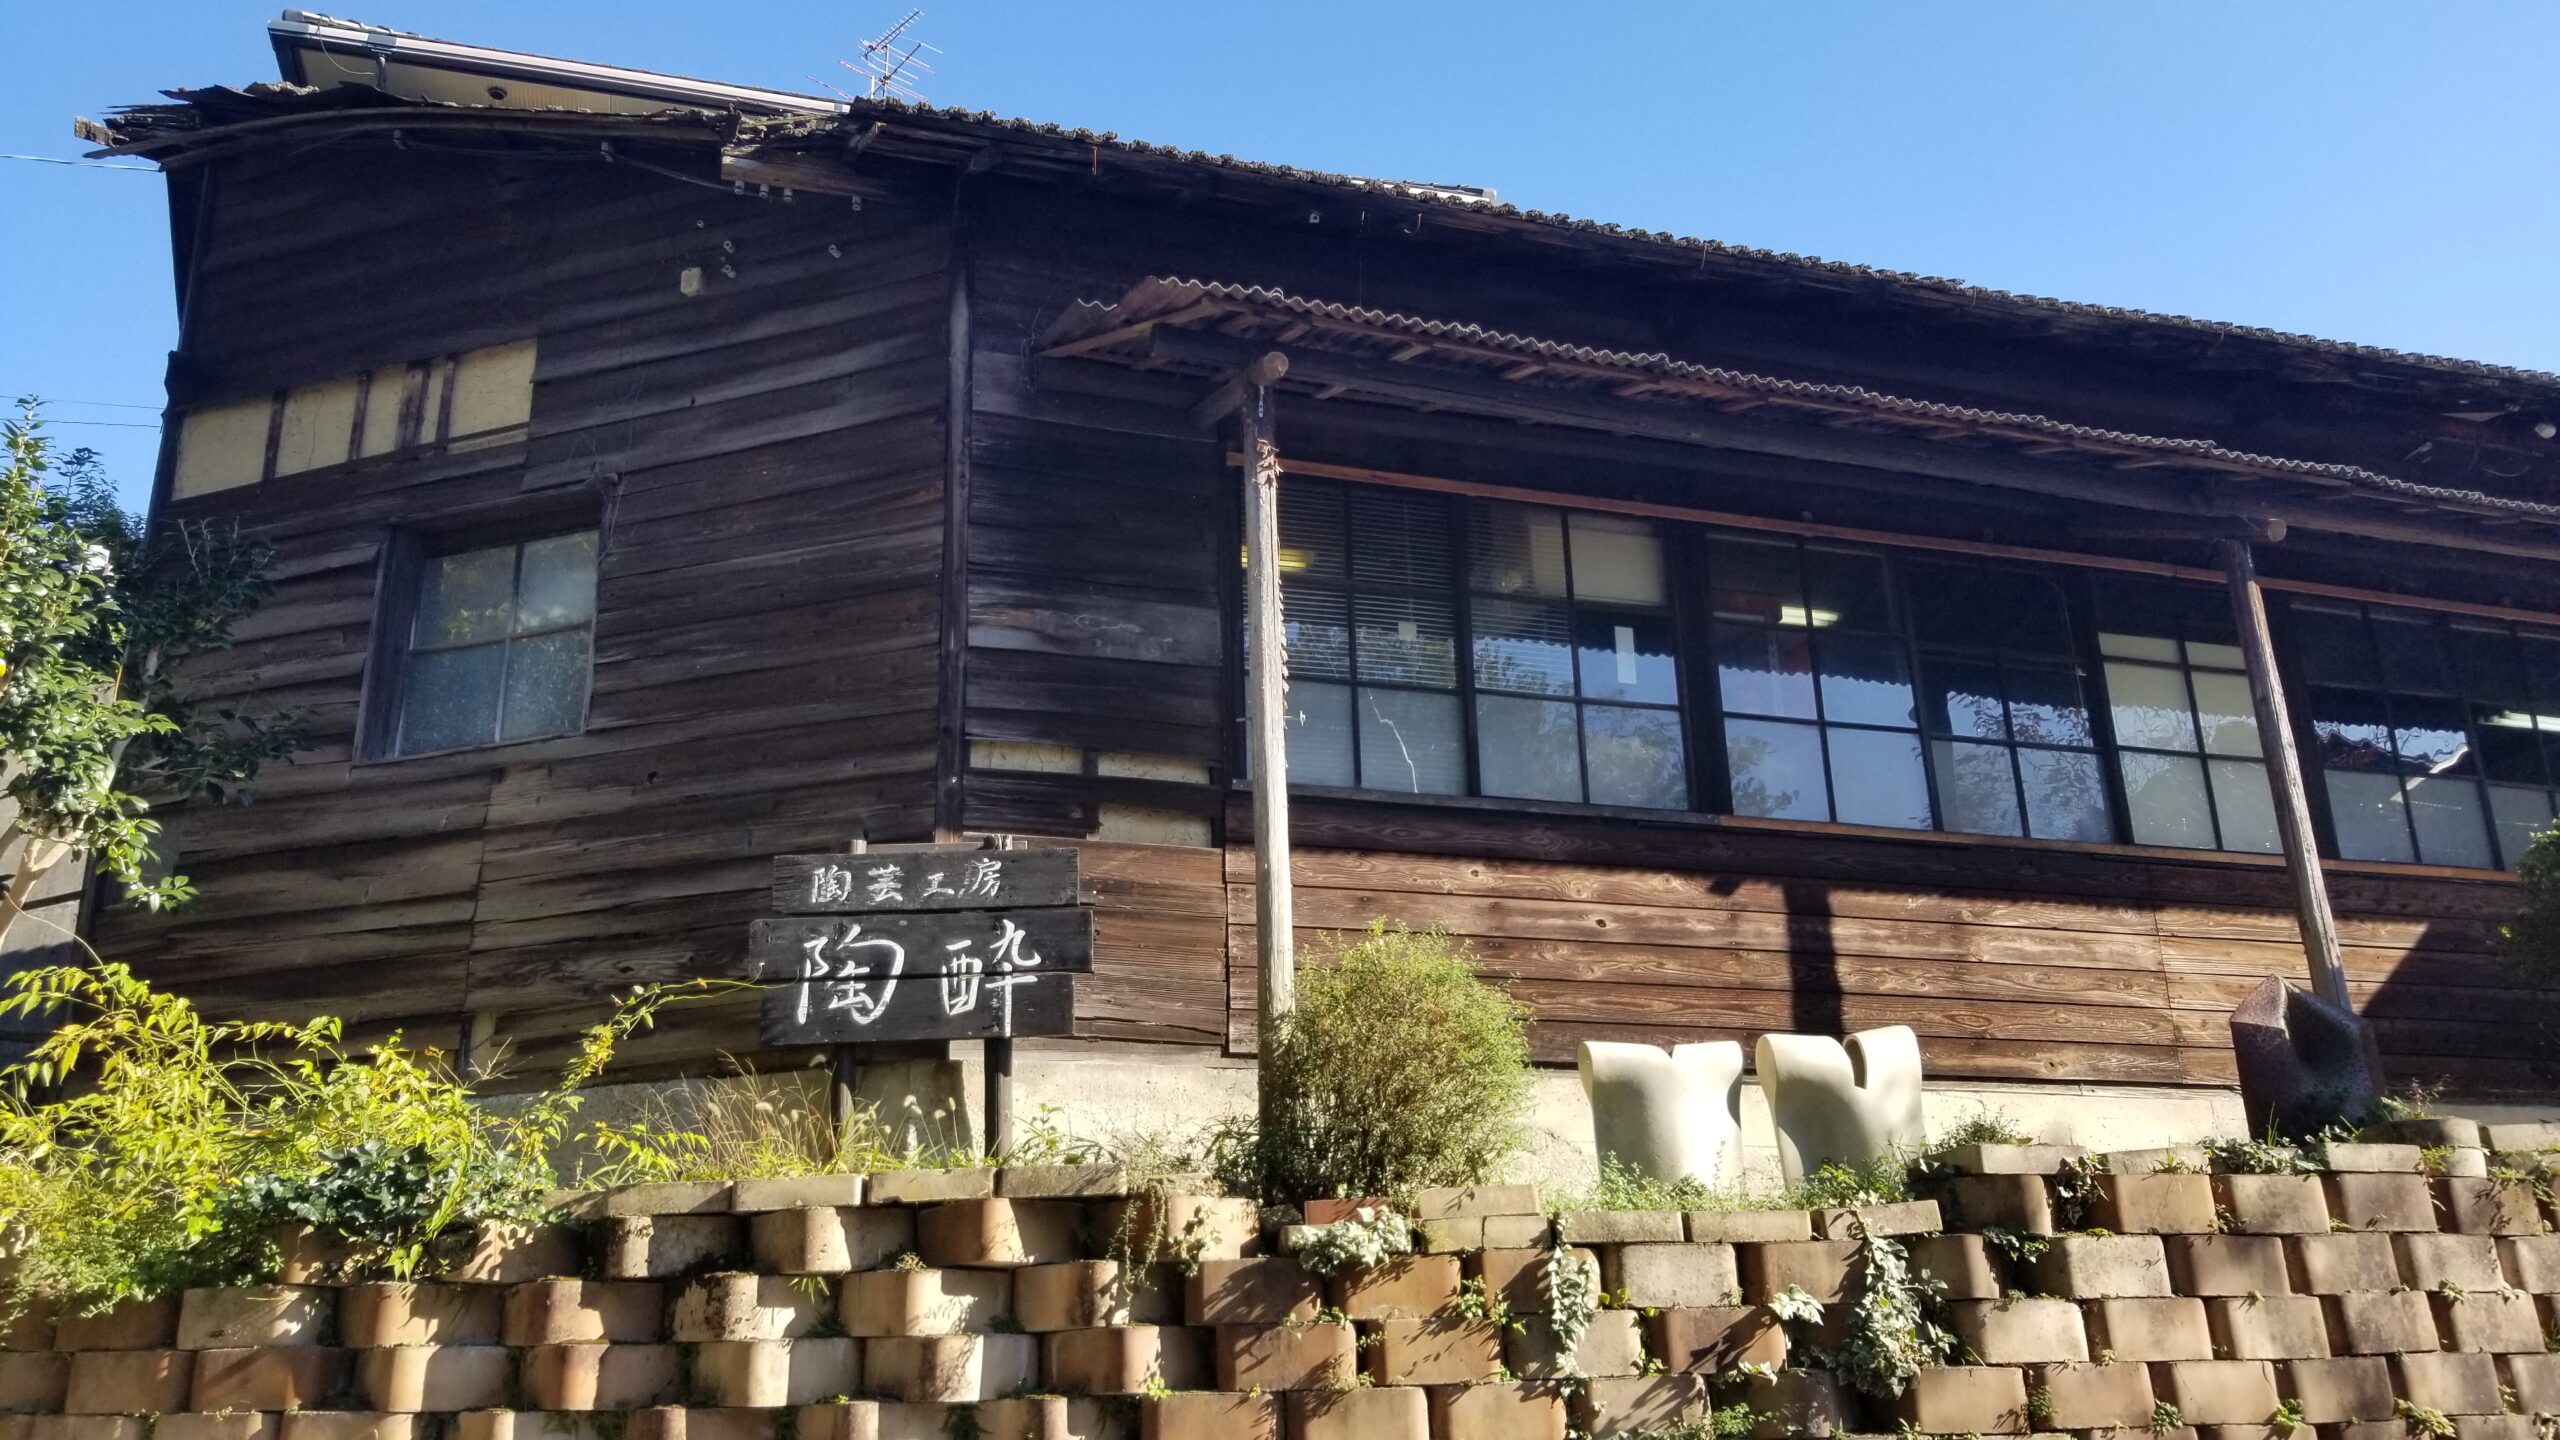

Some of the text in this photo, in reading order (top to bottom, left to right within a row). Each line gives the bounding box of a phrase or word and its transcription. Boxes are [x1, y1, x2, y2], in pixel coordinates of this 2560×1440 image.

[811, 858, 1001, 904] 陶芸工房
[797, 919, 1041, 1037] 陶酔
